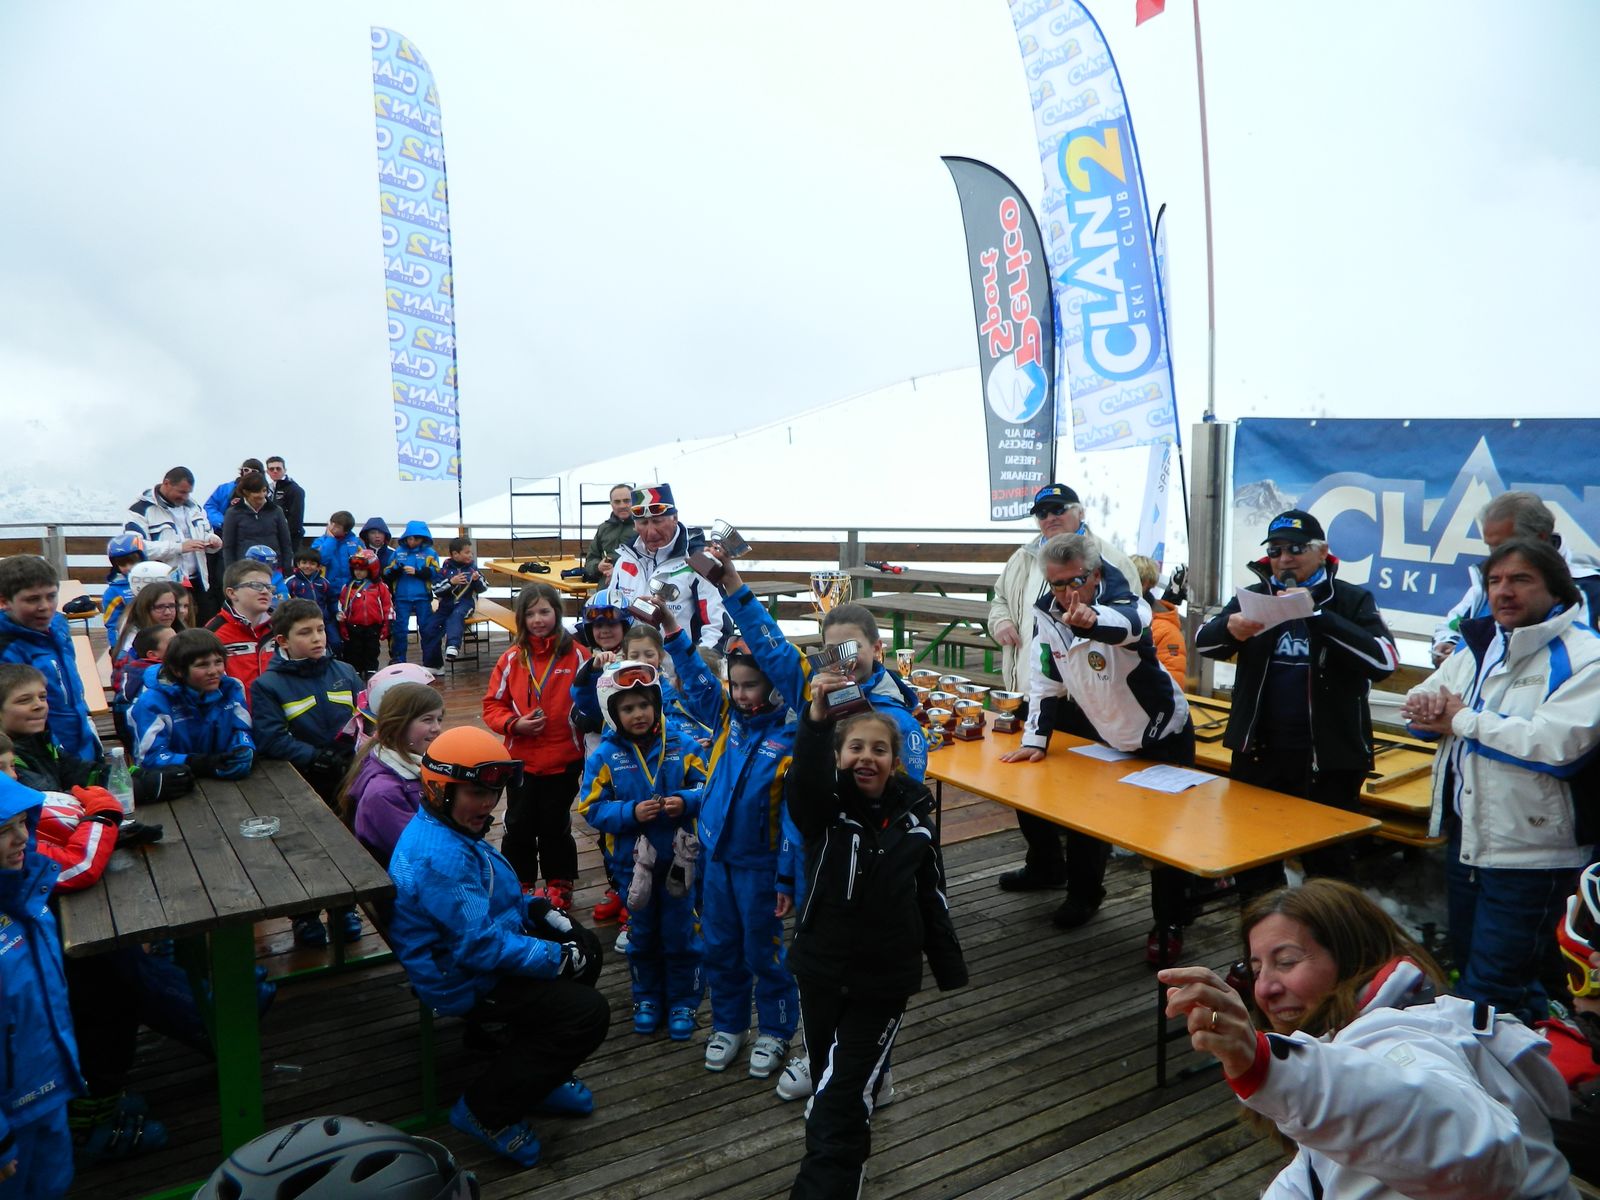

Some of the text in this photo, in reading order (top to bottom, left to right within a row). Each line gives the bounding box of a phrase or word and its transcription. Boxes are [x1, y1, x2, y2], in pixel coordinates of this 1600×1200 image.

[1116, 190, 1136, 247] CLUB
[1065, 127, 1152, 374] CLAN2
[1131, 284, 1146, 318] SKI
[1101, 383, 1162, 414] CLAN2
[1378, 566, 1437, 595] SKI
[1276, 636, 1310, 656] AN
